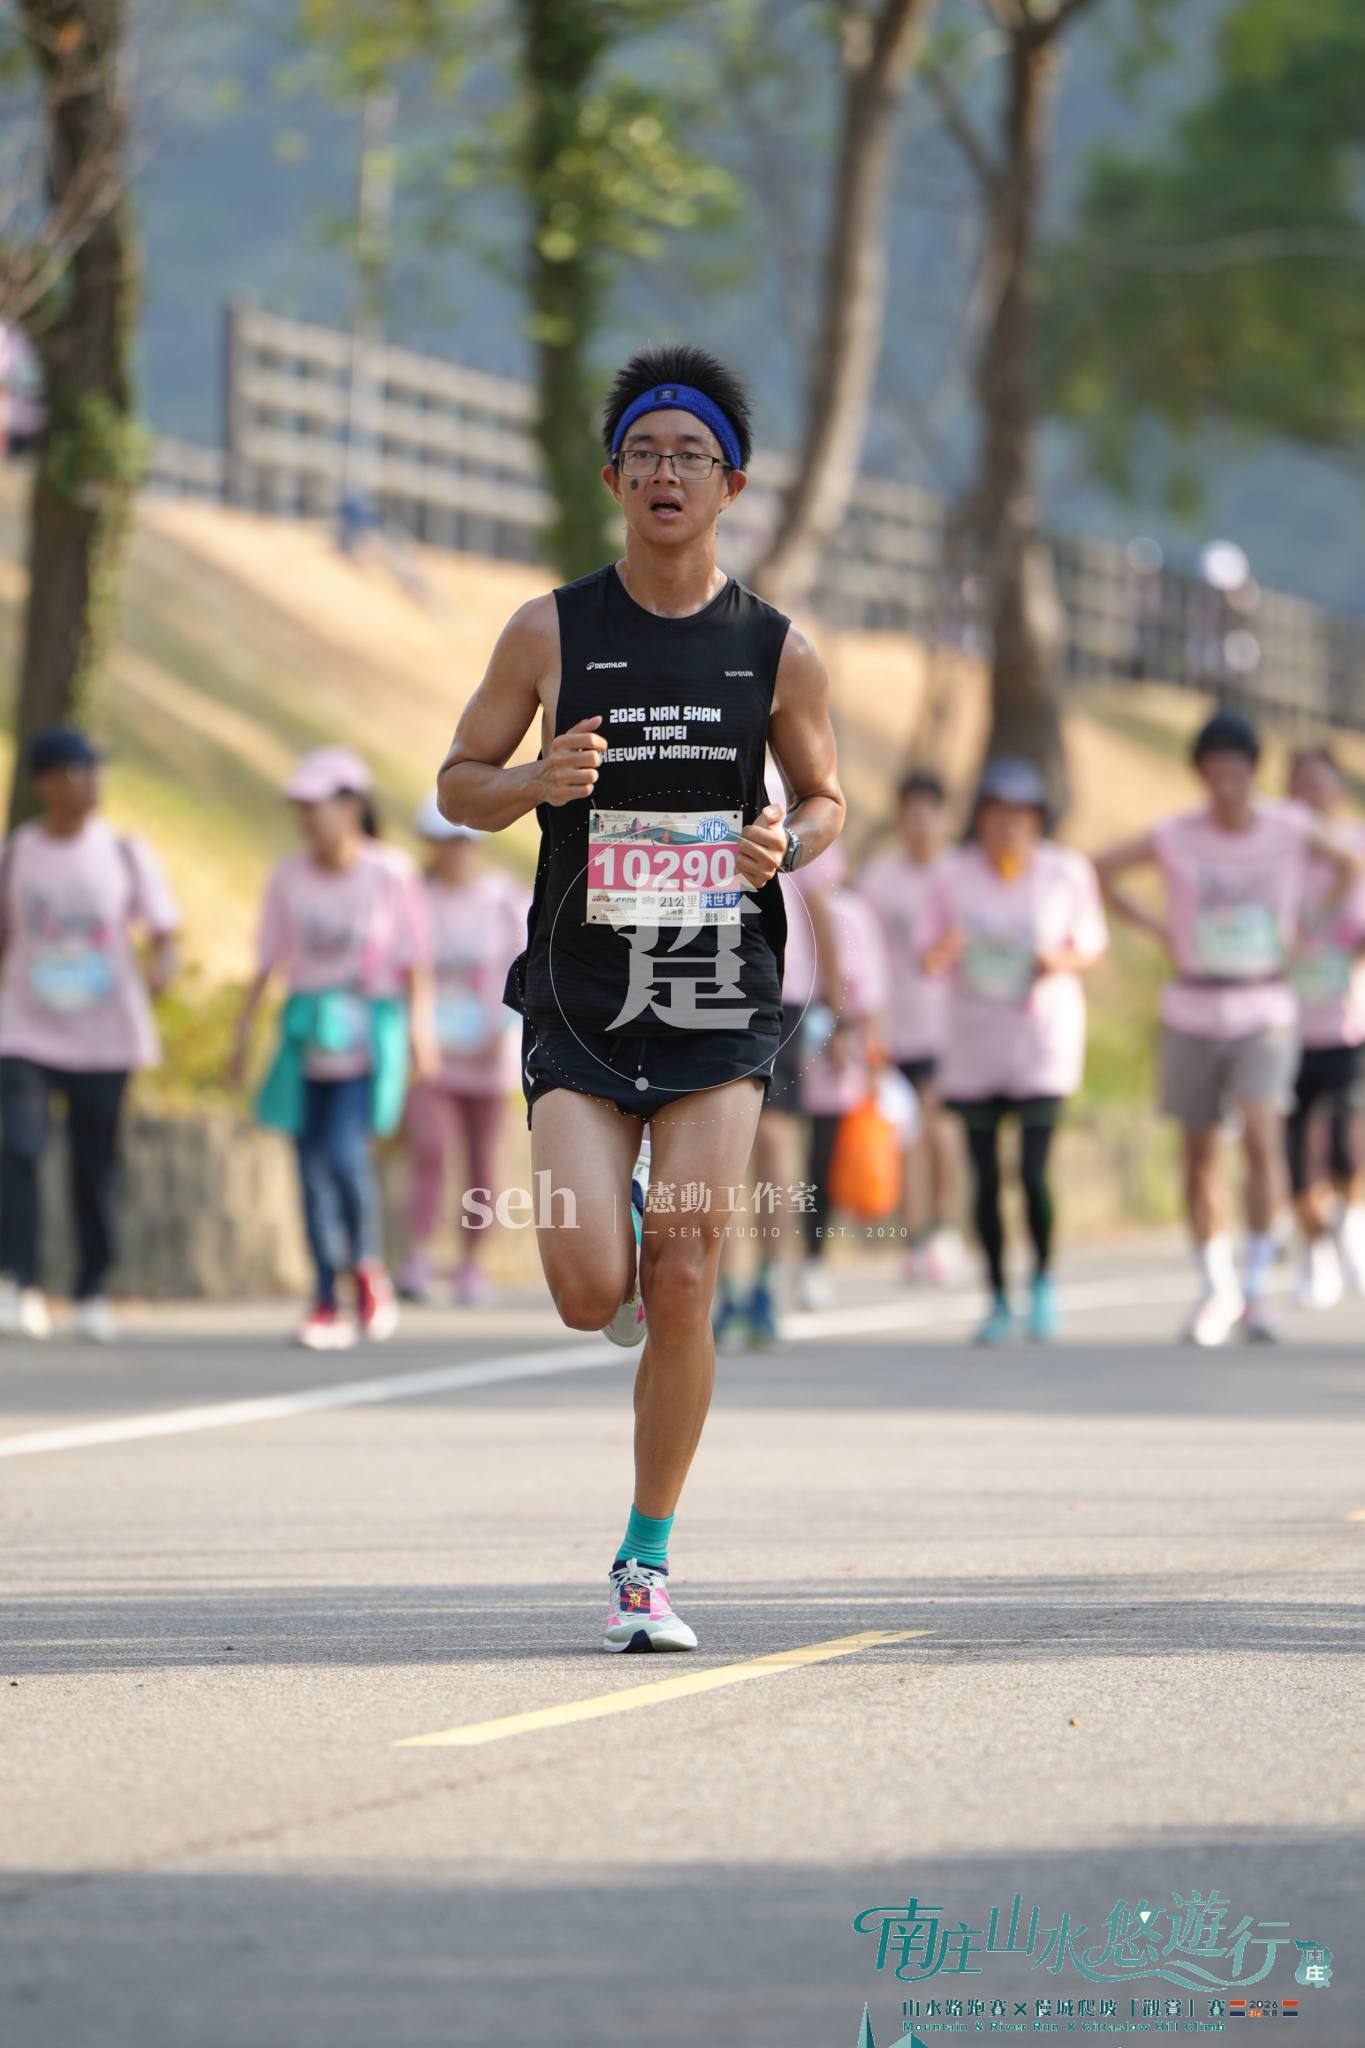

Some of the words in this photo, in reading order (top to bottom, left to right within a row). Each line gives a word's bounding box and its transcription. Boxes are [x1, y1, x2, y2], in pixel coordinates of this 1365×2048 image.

[594, 661, 628, 670] DECATHLON
[609, 708, 646, 724] 2026
[650, 706, 680, 722] NAN
[683, 706, 721, 722] SHAN
[643, 725, 687, 741] TAIPEI
[600, 745, 656, 763] REEWAY
[659, 745, 737, 762] MARATHON
[594, 848, 736, 888] 10290
[660, 895, 697, 908] 21公里
